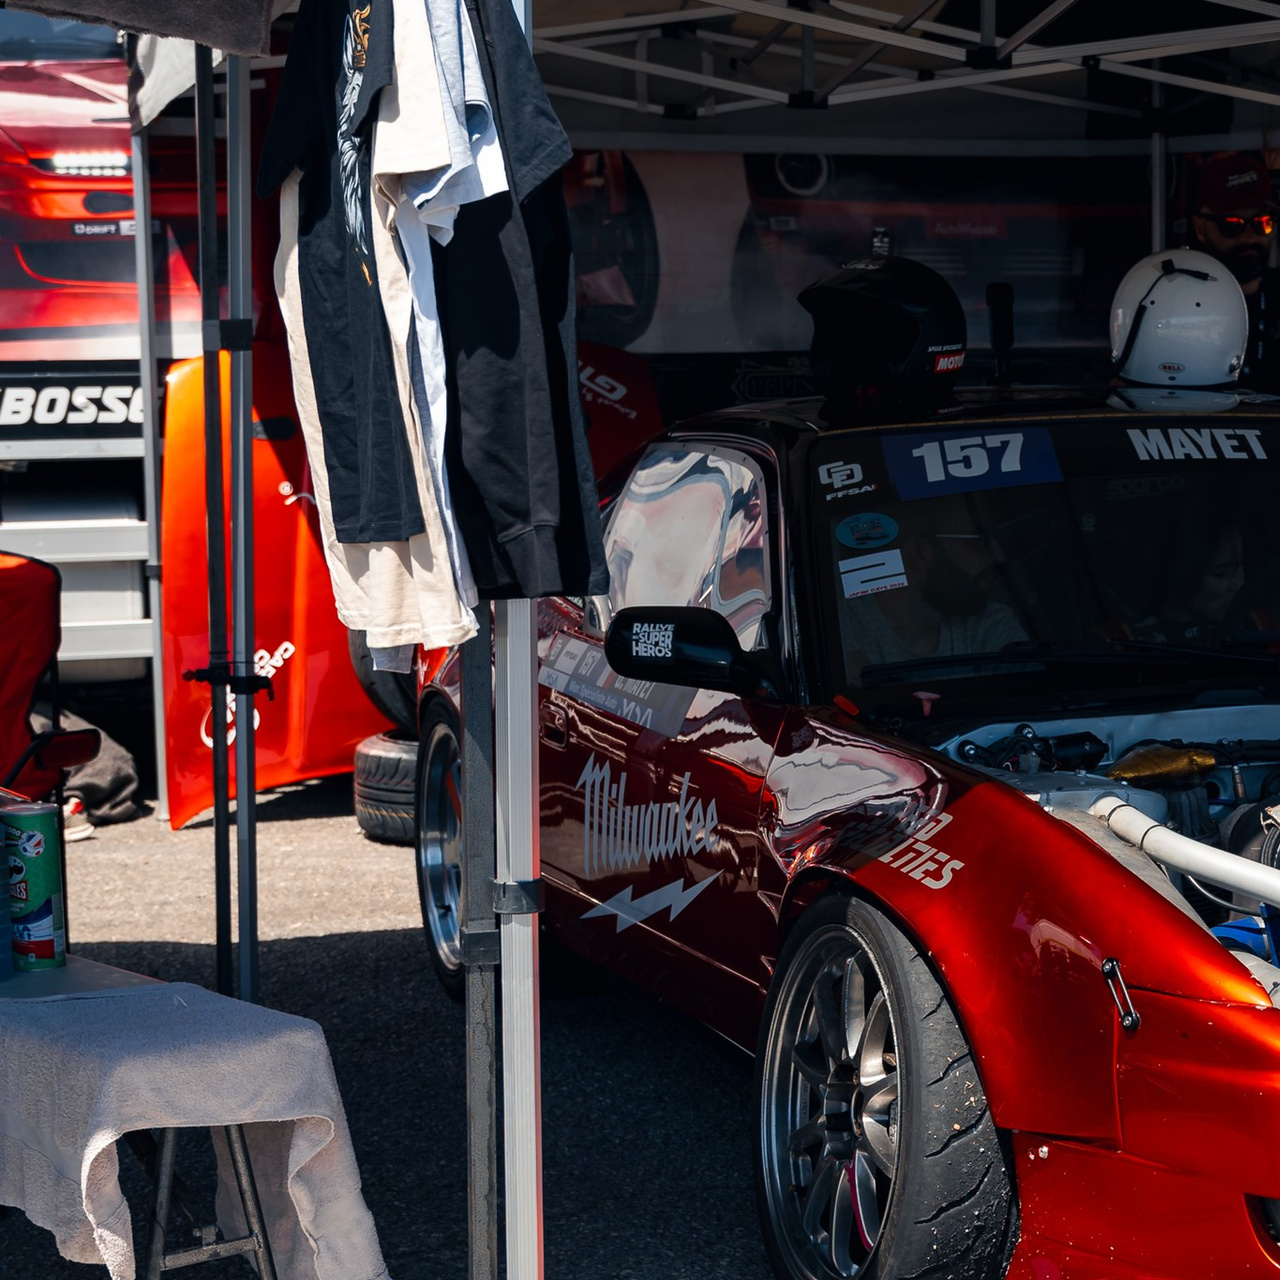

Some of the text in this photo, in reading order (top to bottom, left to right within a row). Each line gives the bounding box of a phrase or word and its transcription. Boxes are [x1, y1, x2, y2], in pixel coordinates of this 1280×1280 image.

[937, 353, 965, 370] MOTU
[1126, 428, 1268, 461] MAYET
[911, 432, 1025, 483] 157
[825, 485, 875, 502] FFSA
[1107, 475, 1185, 500] sparco
[633, 623, 675, 633] RALLYE
[632, 641, 672, 657] HEROS
[639, 631, 673, 650] SUPER
[575, 751, 720, 878] Milwaukee
